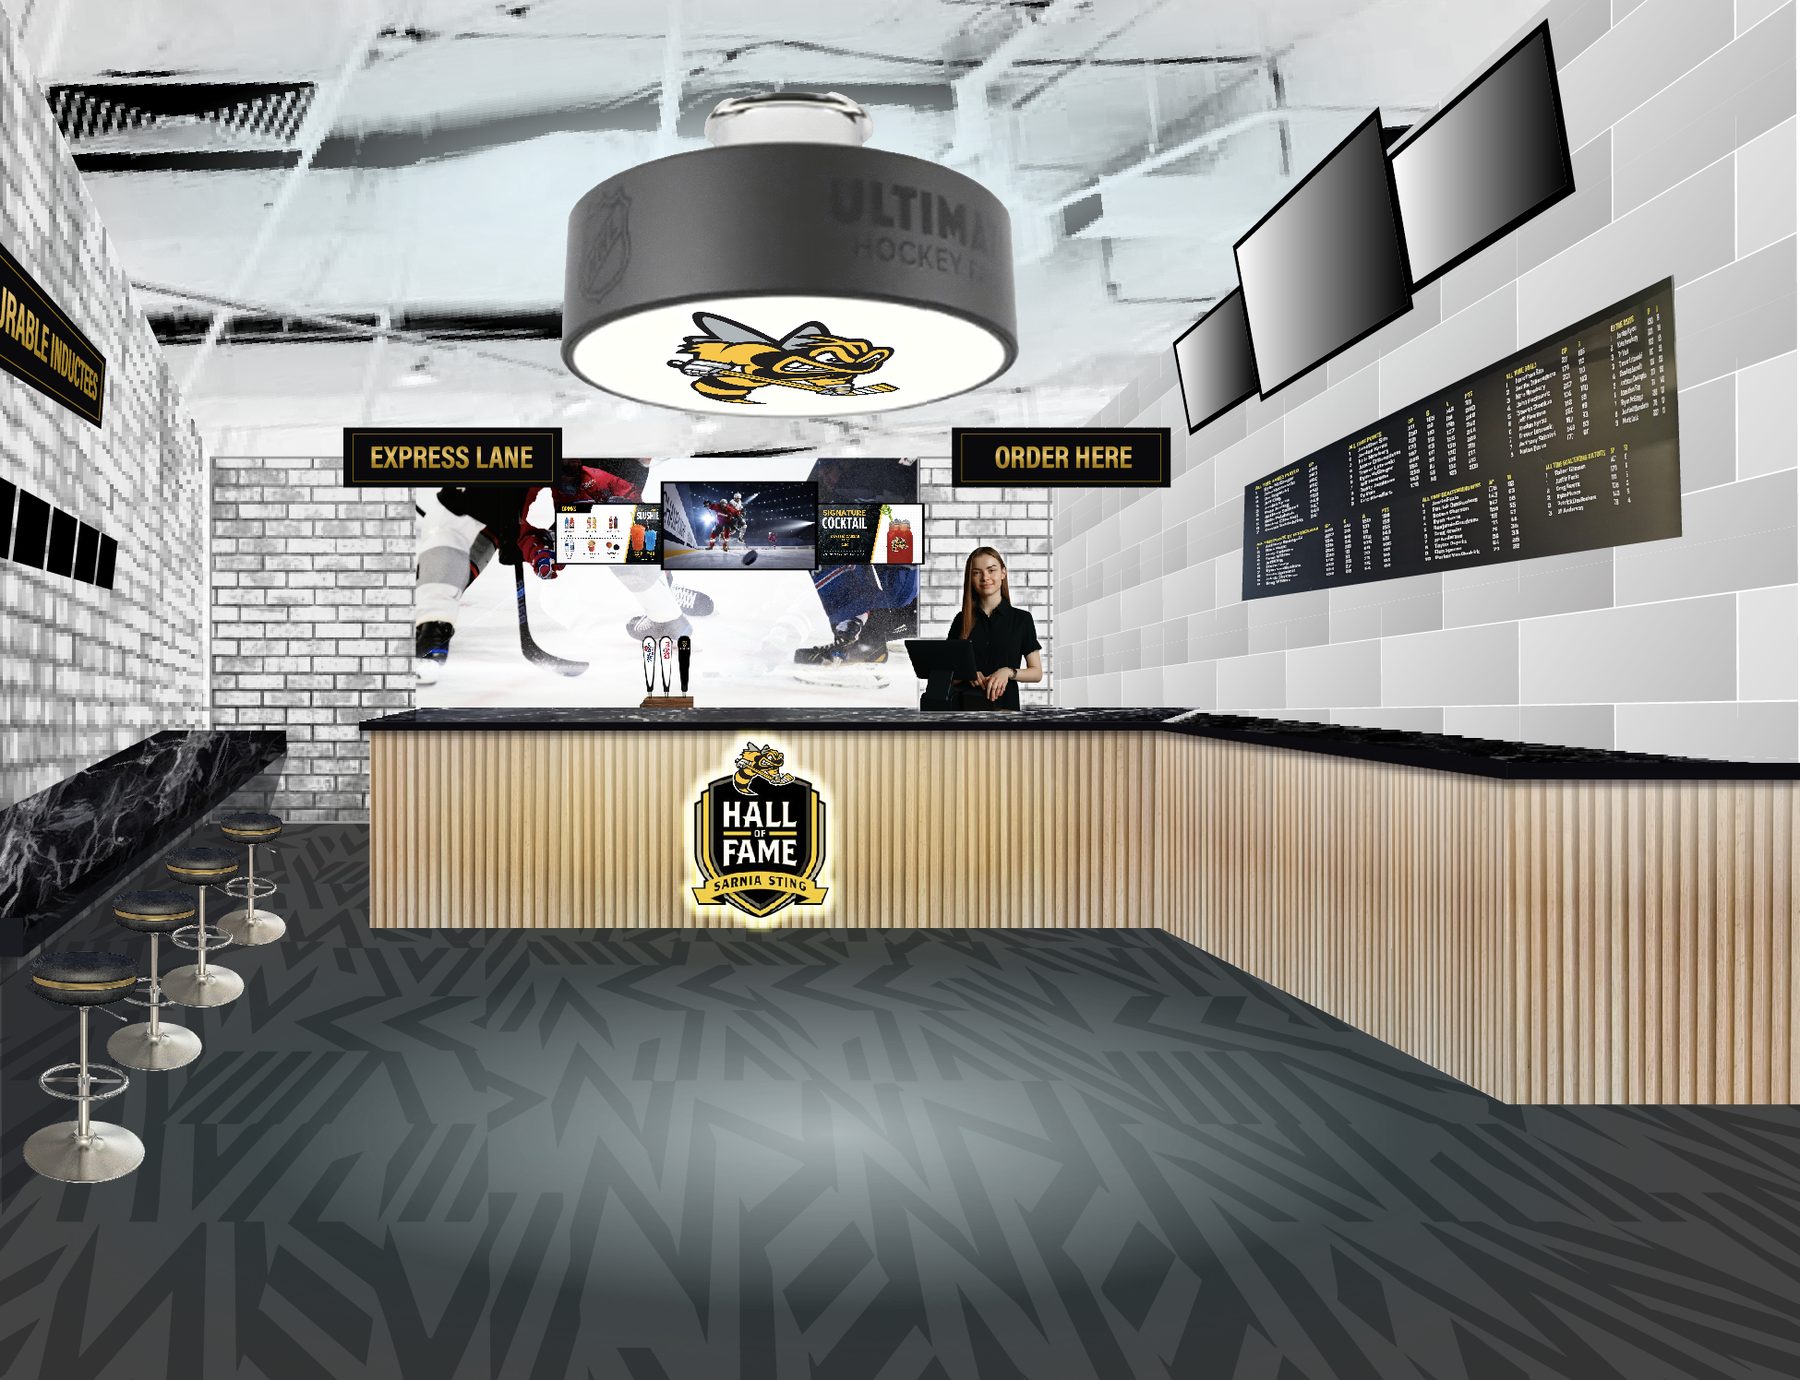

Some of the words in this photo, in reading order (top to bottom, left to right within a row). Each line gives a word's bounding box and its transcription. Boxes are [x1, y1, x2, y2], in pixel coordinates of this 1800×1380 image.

[855, 236, 962, 275] HOCKEY
[50, 333, 98, 401] INDUCTEES
[371, 446, 470, 469] EXPRESS
[477, 446, 534, 469] LANE
[995, 445, 1069, 469] ORDER
[1076, 445, 1133, 469] HERE
[822, 517, 868, 529] COCKTAIL
[723, 801, 797, 827] HALL
[754, 829, 766, 837] OF
[723, 840, 797, 866] FAME
[714, 875, 762, 891] SARNIA
[768, 875, 807, 891] STING
